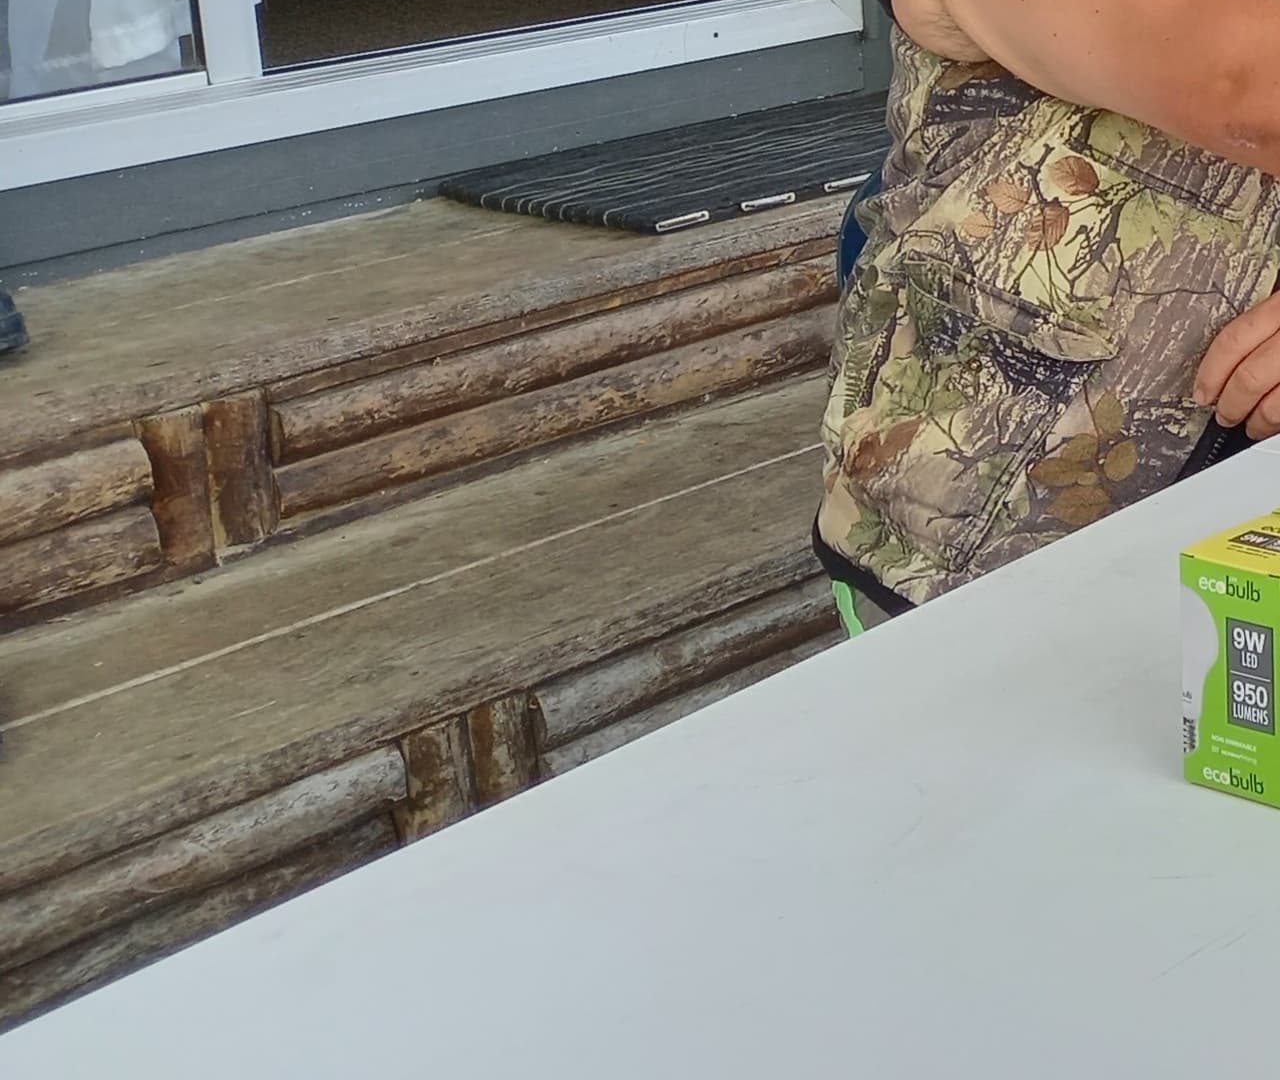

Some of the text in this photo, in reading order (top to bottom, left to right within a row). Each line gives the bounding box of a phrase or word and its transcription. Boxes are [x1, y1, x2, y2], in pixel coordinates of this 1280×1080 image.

[1239, 533, 1268, 543] 9W
[1198, 575, 1260, 602] ecobulb
[1233, 627, 1265, 653] 9W
[1241, 652, 1258, 669] LED
[1232, 680, 1268, 708] 950
[1232, 704, 1269, 726] LUMENS
[1202, 767, 1265, 794] ecobulb
